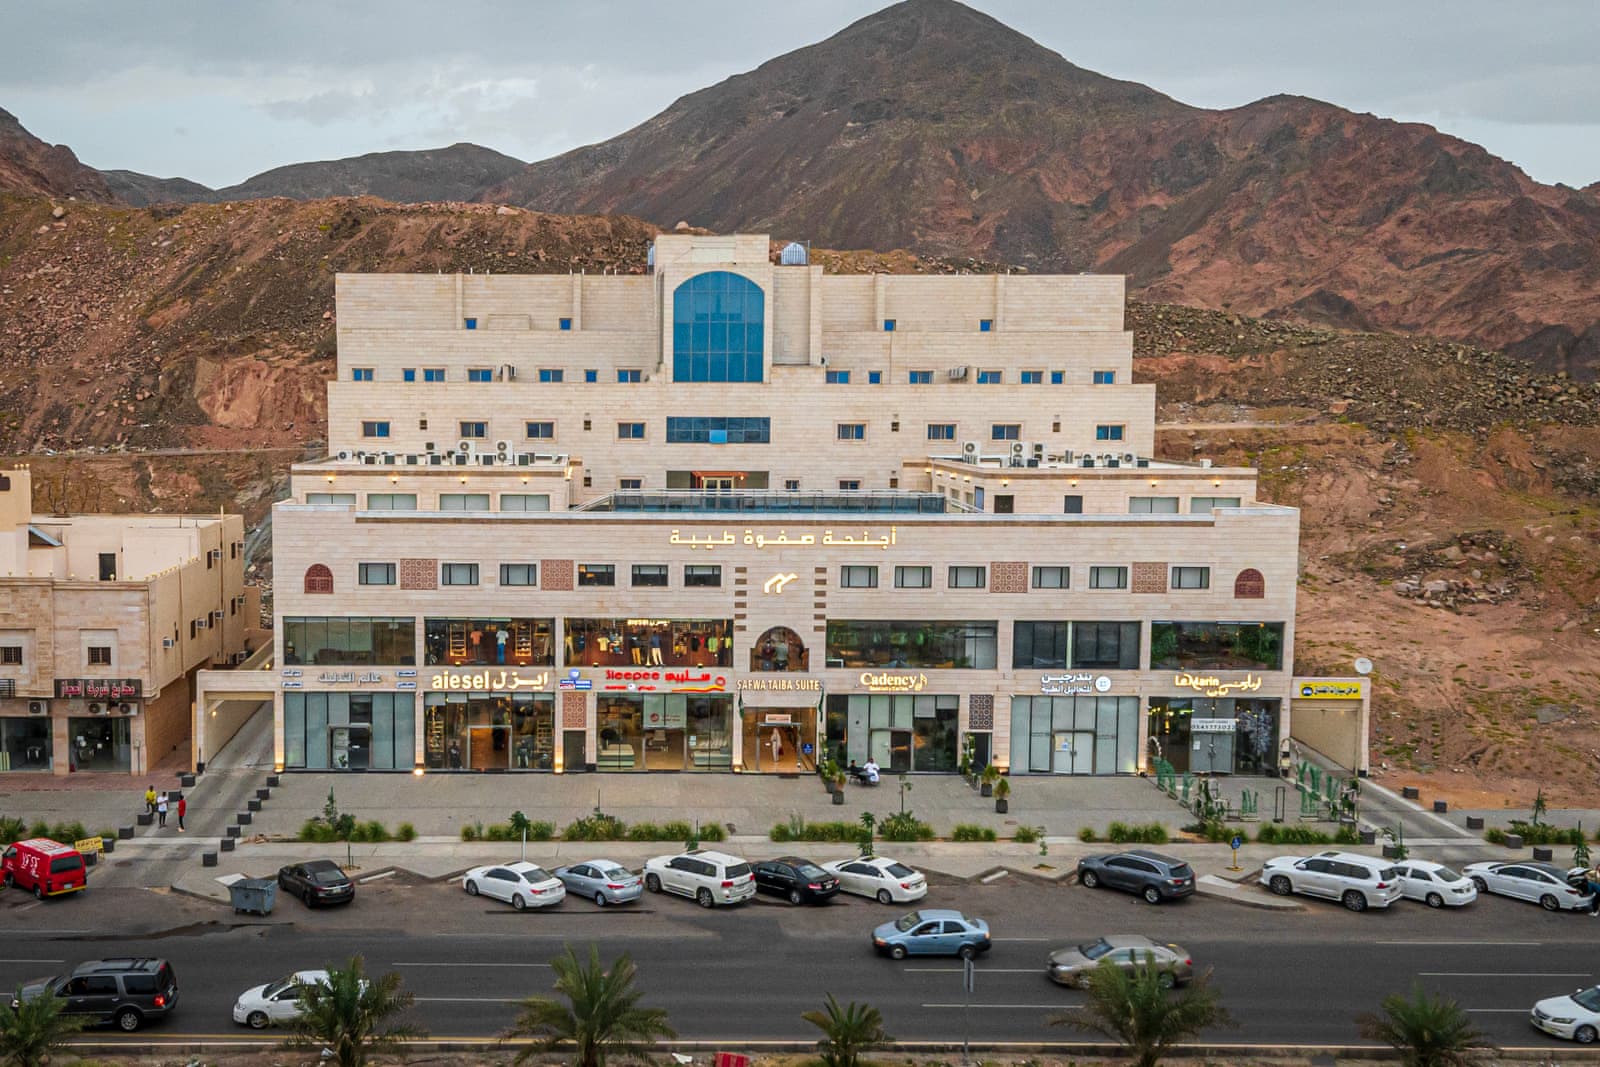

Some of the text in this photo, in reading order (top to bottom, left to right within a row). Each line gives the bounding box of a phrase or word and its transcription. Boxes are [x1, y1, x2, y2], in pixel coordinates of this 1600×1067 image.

[670, 526, 896, 549] أجنحة صفوة طيبة
[432, 670, 490, 689] aiesel
[736, 680, 820, 690] SAFWA TAIBA SUITE
[860, 672, 917, 688] Cadency
